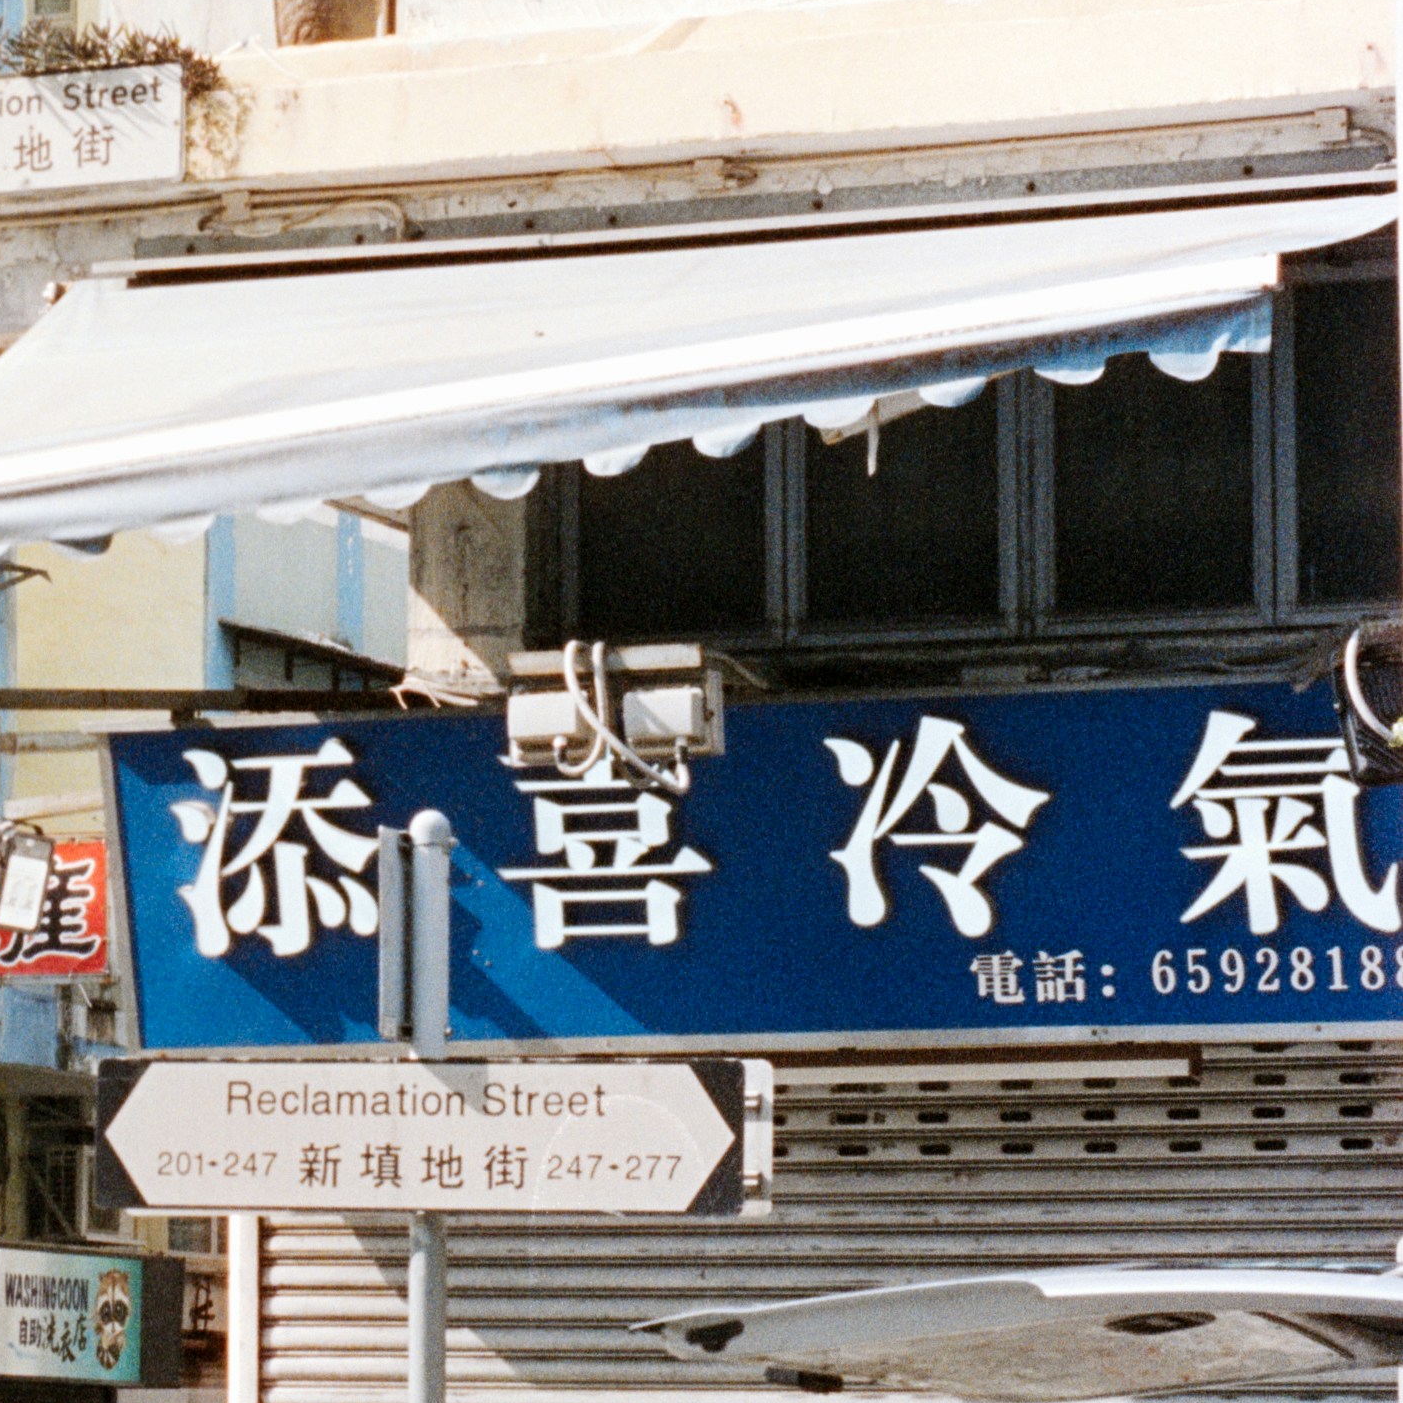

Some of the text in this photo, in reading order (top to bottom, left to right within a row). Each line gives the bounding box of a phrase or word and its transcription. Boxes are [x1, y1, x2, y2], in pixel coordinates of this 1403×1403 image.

[62, 75, 163, 111] Street
[169, 709, 1402, 958] 添喜冷氣
[227, 1080, 606, 1118] Reclamation Street
[156, 1142, 682, 1190] 201-247 新填地街 247-277
[5, 1272, 90, 1313] WASHINGCOON
[19, 1312, 88, 1363] 自助洗衣店
